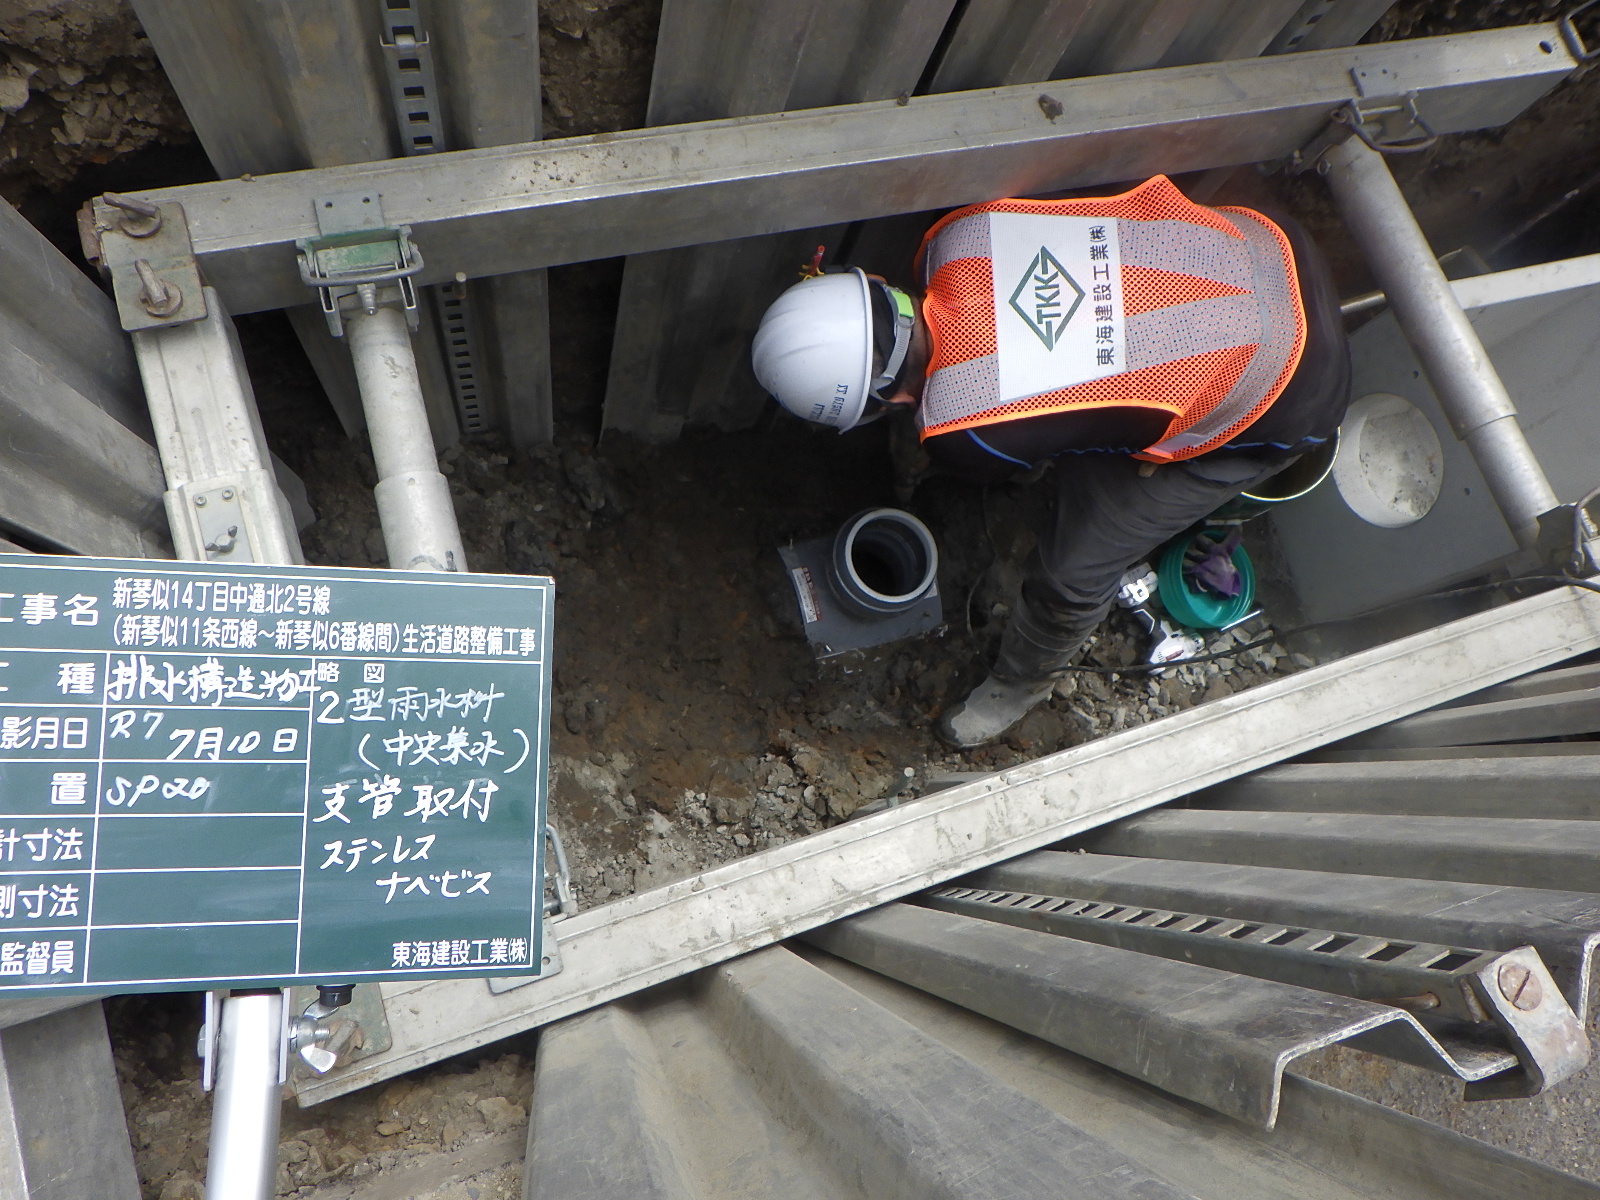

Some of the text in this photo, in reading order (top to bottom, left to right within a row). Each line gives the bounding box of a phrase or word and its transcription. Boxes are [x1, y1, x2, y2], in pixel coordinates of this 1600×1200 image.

[1033, 271, 1062, 325] TKK
[112, 577, 331, 616] 新琴似14丁目中通北2号線
[319, 834, 436, 873] ステンレス
[375, 869, 492, 905] ナベビス
[0, 940, 74, 975] 監督員
